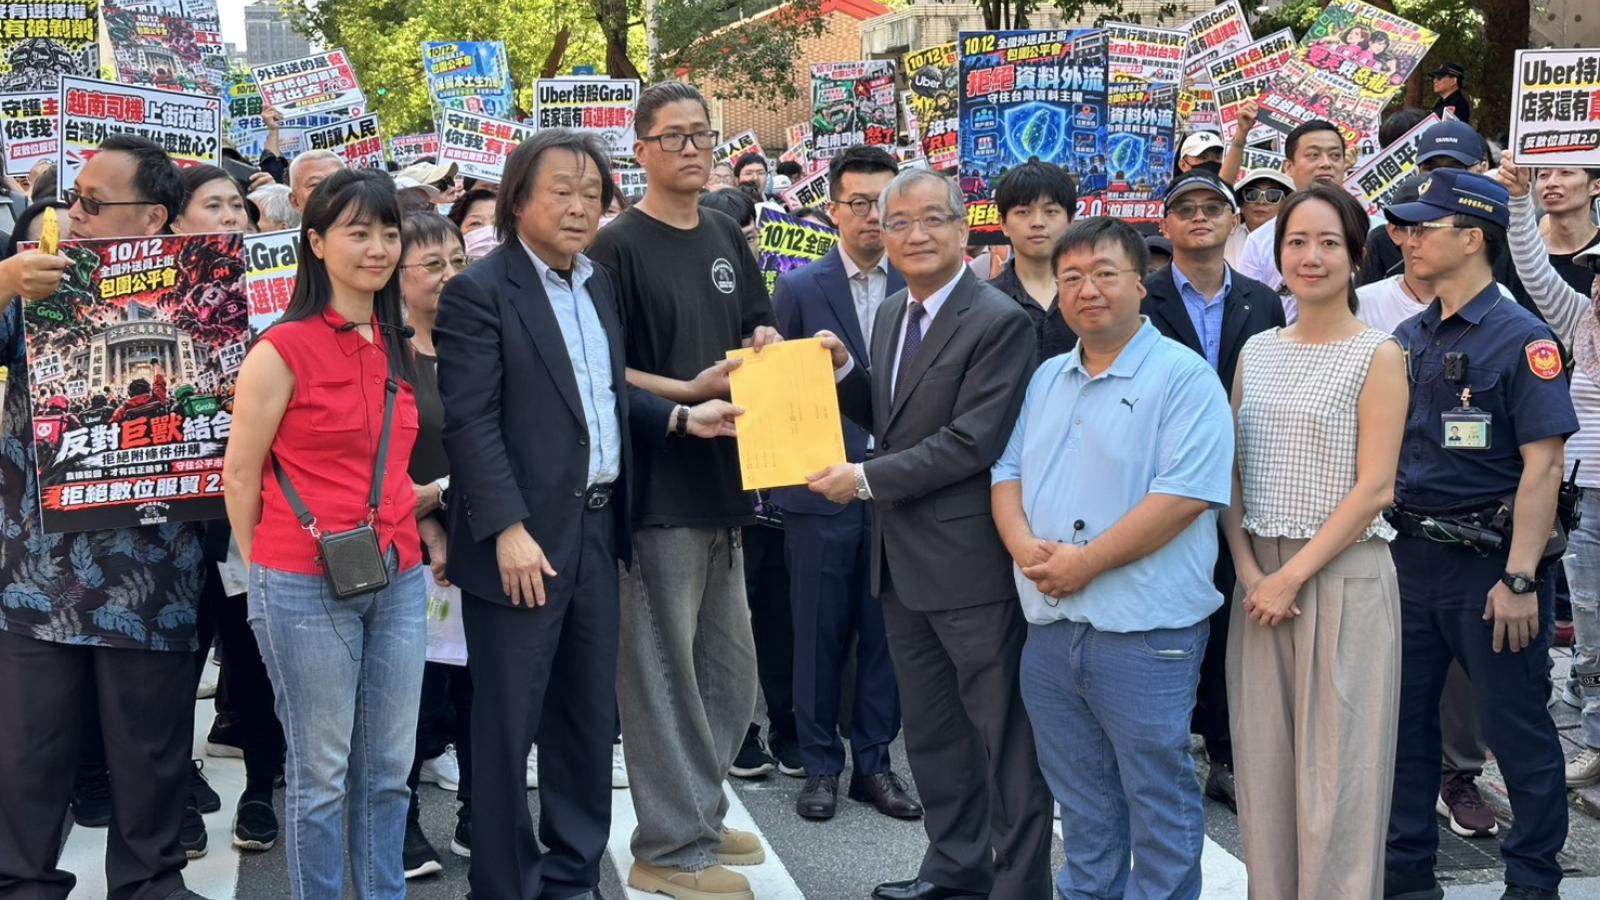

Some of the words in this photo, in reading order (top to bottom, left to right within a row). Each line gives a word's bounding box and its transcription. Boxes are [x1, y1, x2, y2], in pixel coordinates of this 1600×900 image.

[136, 14, 159, 22] 10/12
[0, 19, 94, 41] 有被剝削
[997, 31, 1067, 49] 全國外送員上街
[429, 45, 454, 57] 10/12
[909, 48, 942, 72] 10/12
[1007, 42, 1063, 61] 包圍公平會
[915, 75, 940, 89] Uber
[966, 64, 1105, 98] 拒絕資料外流
[1522, 56, 1600, 86] Uber持
[540, 84, 633, 104] Uber持股Grab
[987, 90, 1083, 104] 守住台灣資料主權
[65, 88, 214, 133] 越南司機上街抗議
[1520, 89, 1600, 122] 店家還有真
[540, 106, 635, 129] 店家還有真選擇嗎?
[1110, 107, 1174, 128] 資料外流
[5, 118, 58, 140] 你我
[310, 118, 377, 150] 別讓人民
[1524, 133, 1597, 149] 反數位服貿2.0
[1073, 199, 1103, 220] 2.0
[108, 238, 163, 263] 10/12
[100, 254, 175, 278] 全國外送員上街
[99, 266, 178, 299] 包圍公平會
[36, 306, 64, 321] Grab
[40, 366, 60, 377] 工作
[52, 410, 232, 468] 反對巨獸結合
[102, 442, 200, 466] 拒絕附條件併購
[176, 458, 225, 472] 守住公平市
[60, 474, 200, 506] 拒絕數位服貿
